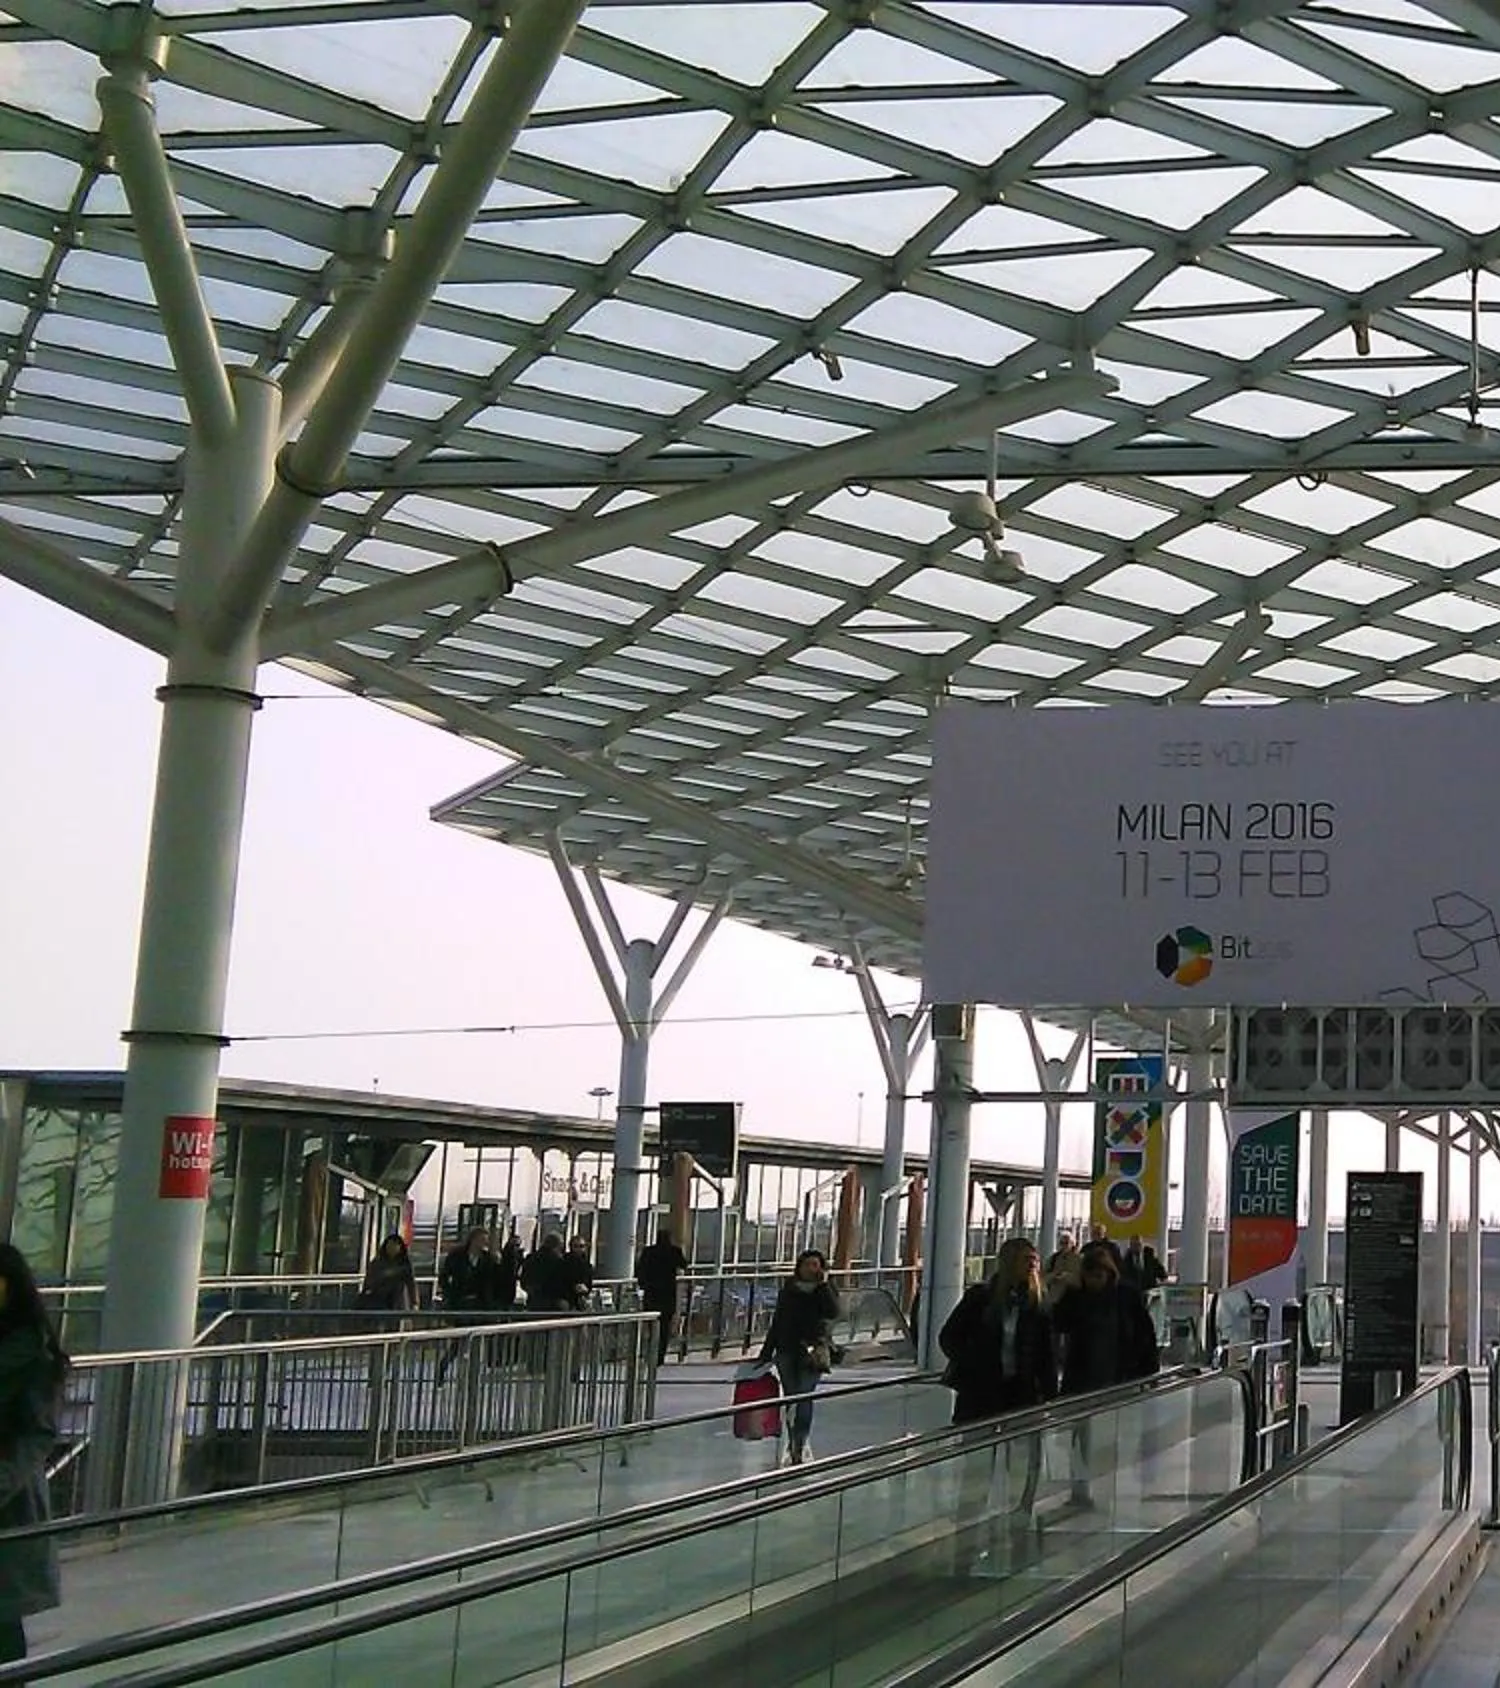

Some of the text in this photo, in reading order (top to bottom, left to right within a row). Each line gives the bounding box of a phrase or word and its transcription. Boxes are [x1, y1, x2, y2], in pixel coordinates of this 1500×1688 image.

[1159, 739, 1299, 768] SEE YOU AT
[1117, 803, 1335, 841] MILAN 2016
[1115, 850, 1331, 899] 11-13 FEB
[1220, 934, 1252, 960] Bit
[1240, 1144, 1290, 1166] SAVE
[1240, 1167, 1289, 1193] THE
[1238, 1193, 1289, 1215] DATE
